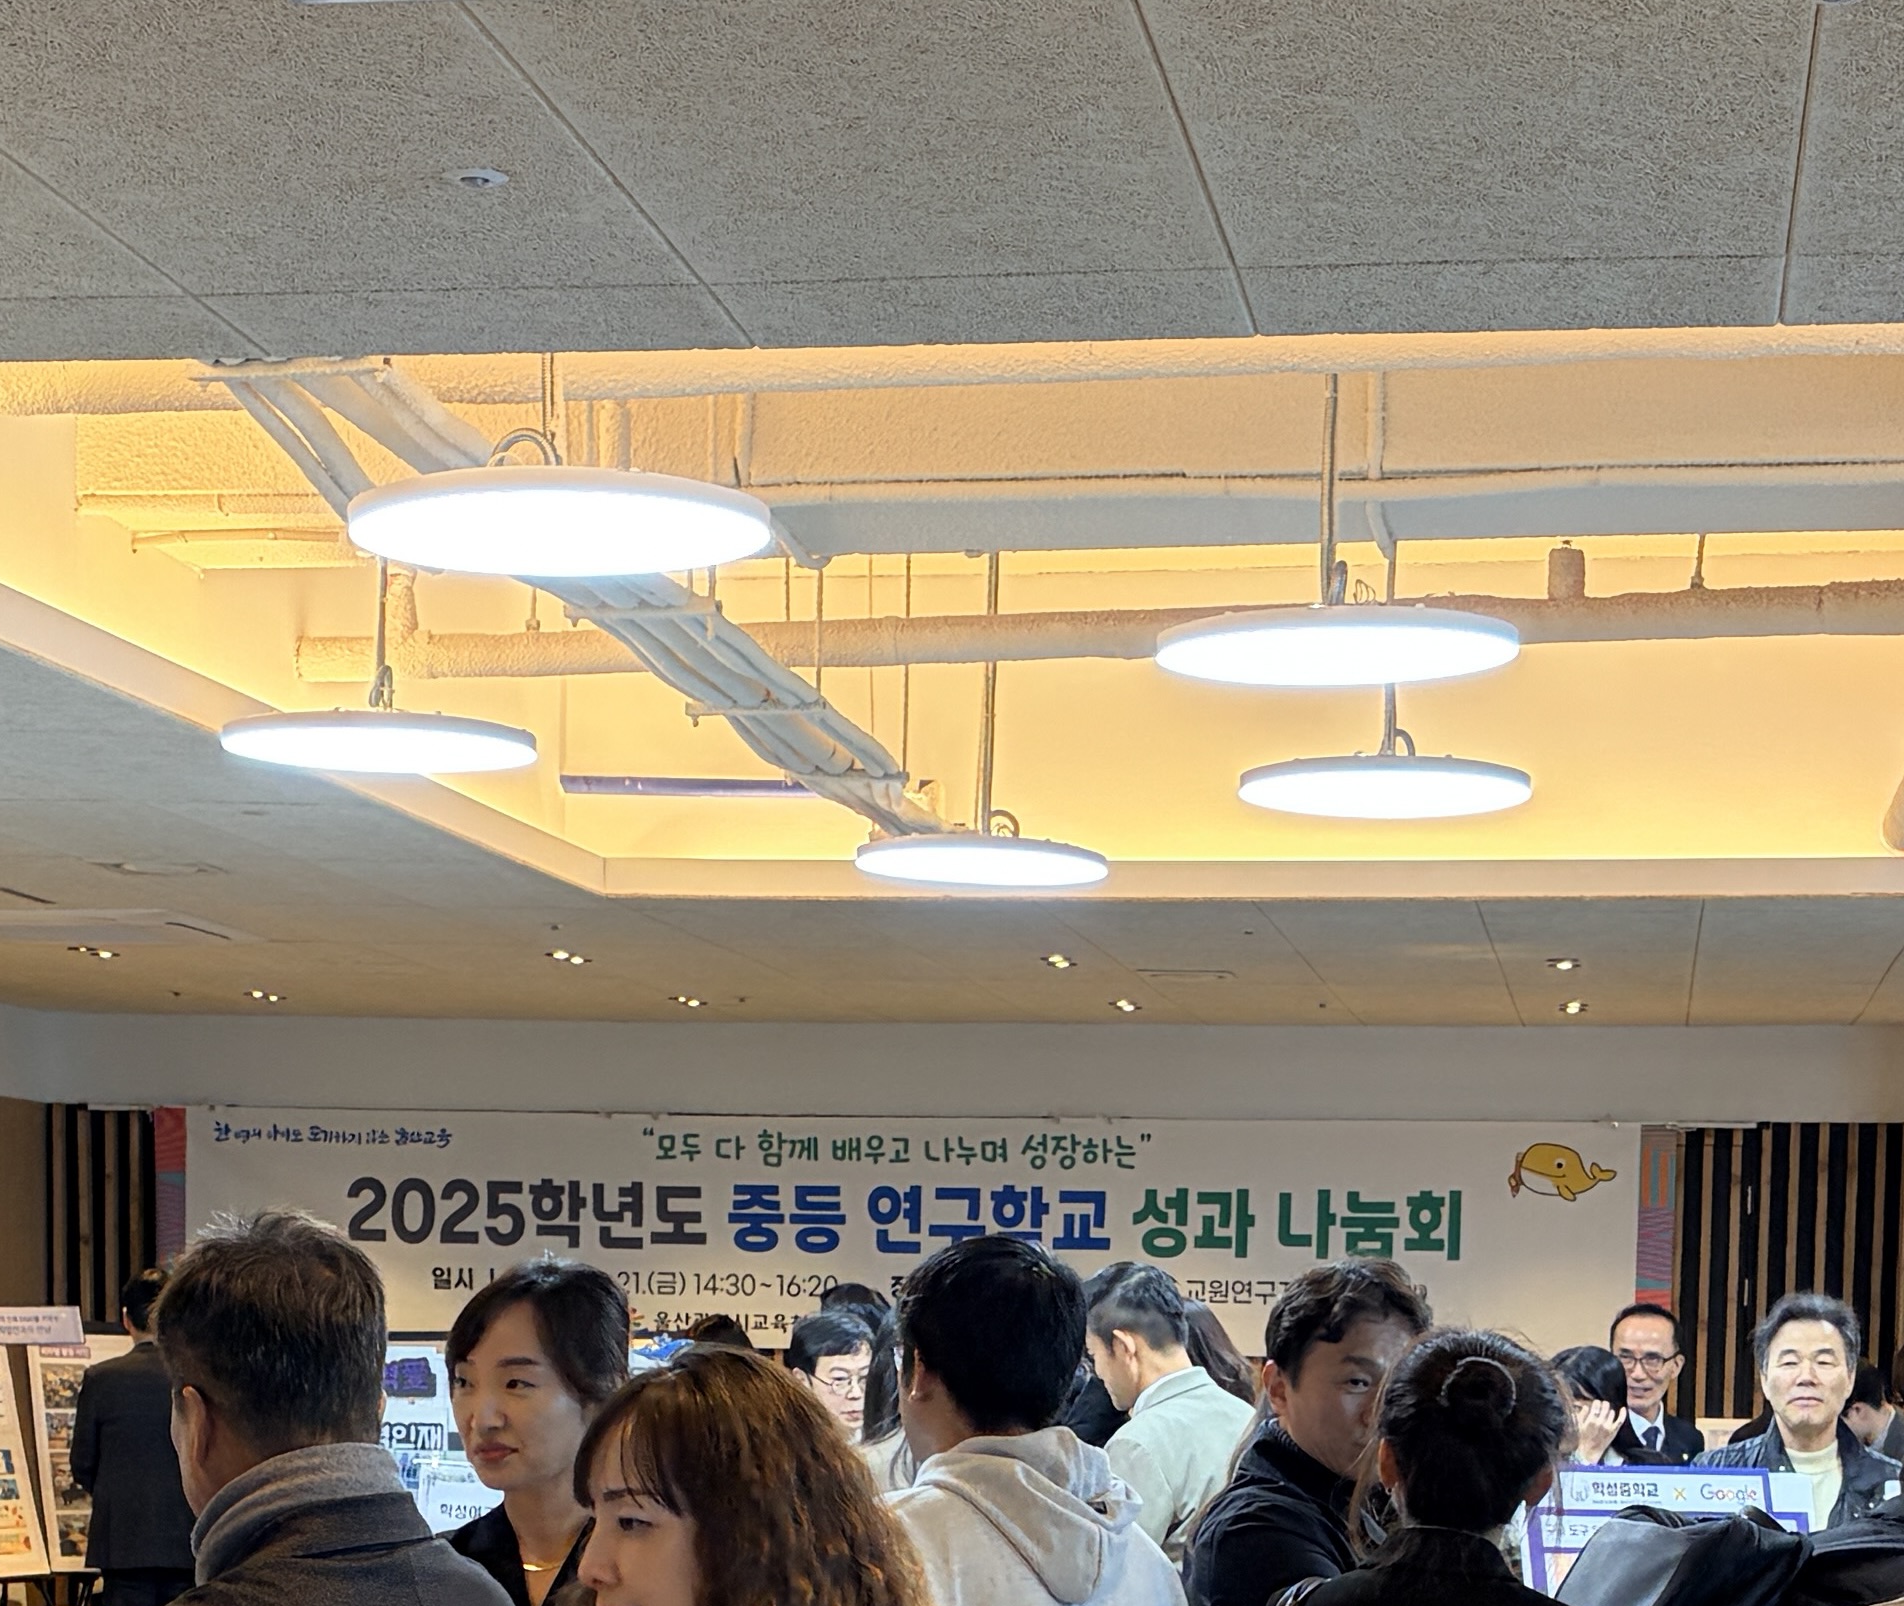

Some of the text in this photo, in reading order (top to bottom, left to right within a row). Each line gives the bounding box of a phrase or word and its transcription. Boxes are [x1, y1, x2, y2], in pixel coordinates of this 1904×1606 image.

[715, 1135, 746, 1161] 다
[757, 1128, 819, 1168] 함께
[831, 1134, 911, 1165] 배우고
[924, 1134, 1008, 1165] 나누며
[346, 1176, 1463, 1261] 2025학년도 중등 연구학교 성과 나눔회
[432, 1266, 475, 1291] 일시
[1186, 1279, 1287, 1306] 교원연구
[439, 1503, 494, 1520] 학성여
[1699, 1483, 1758, 1506] Google
